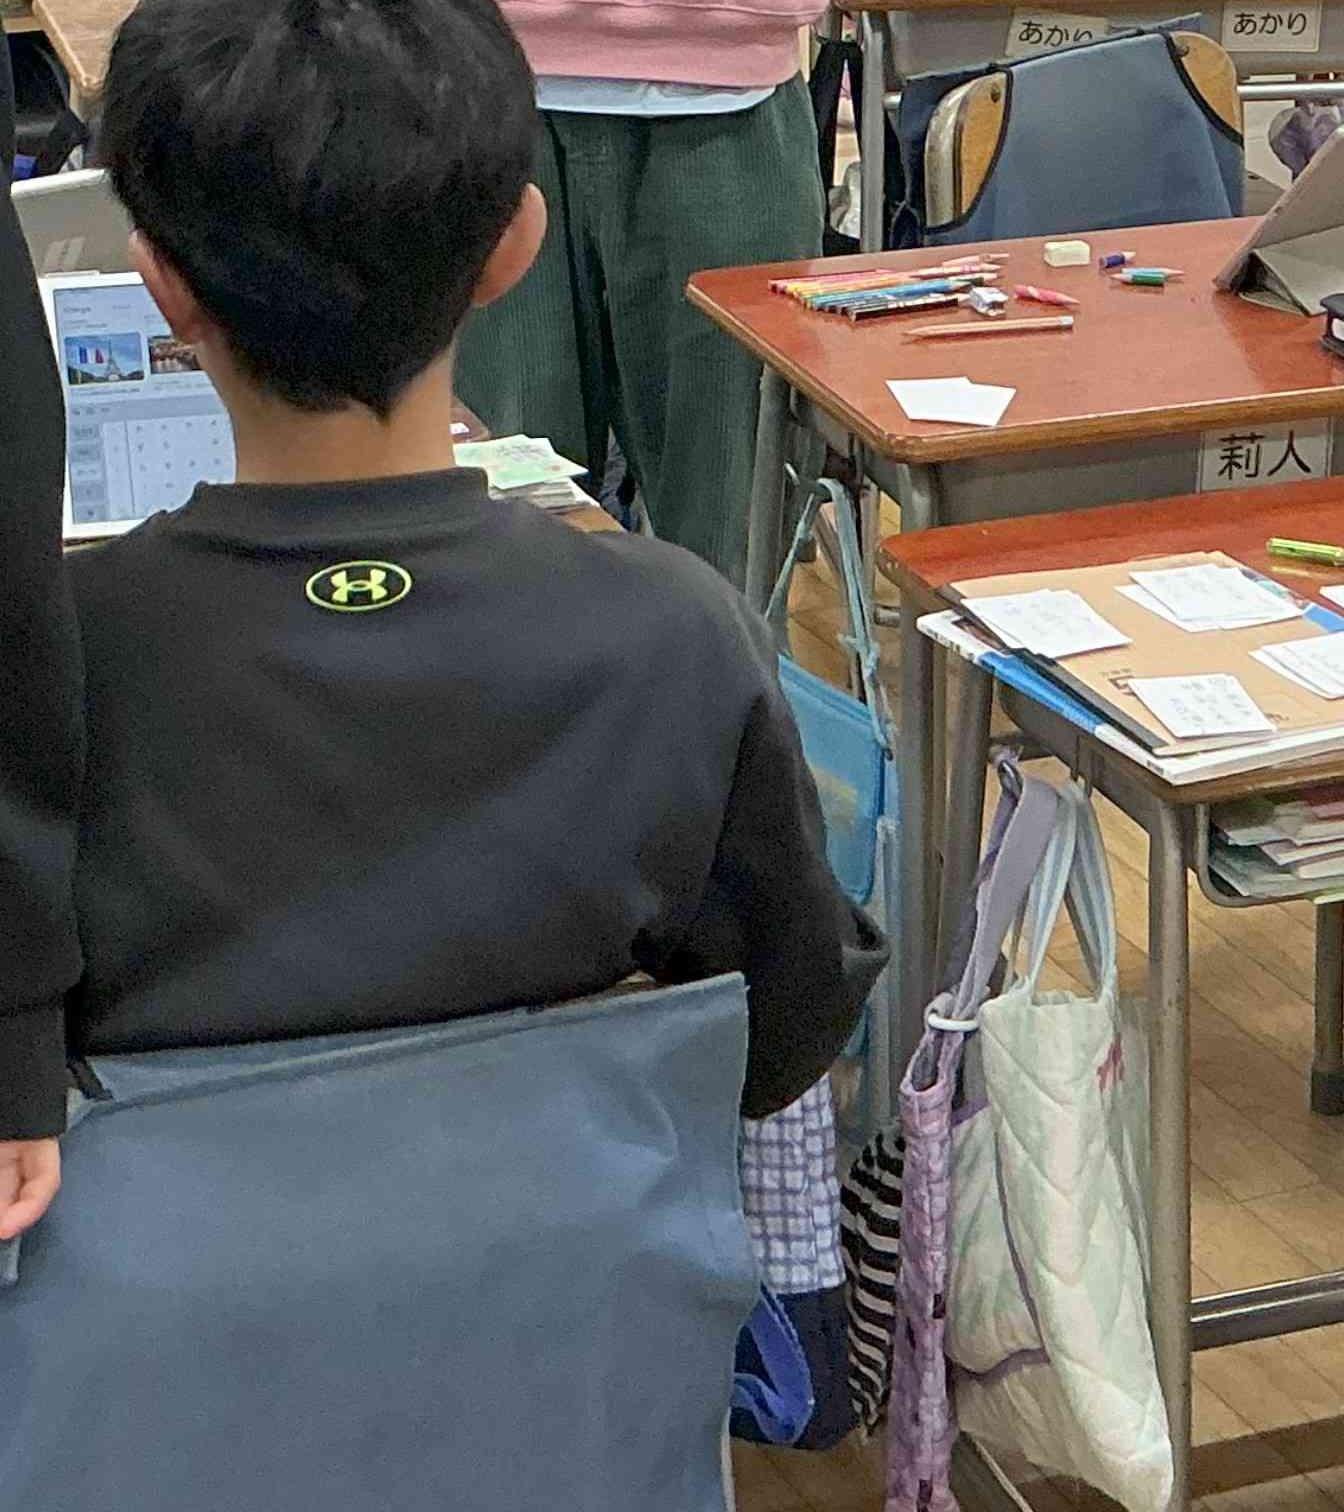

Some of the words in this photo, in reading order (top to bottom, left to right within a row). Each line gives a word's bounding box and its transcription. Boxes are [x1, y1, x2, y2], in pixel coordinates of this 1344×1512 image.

[1233, 10, 1307, 36] あかり
[1217, 430, 1312, 481] 莉人
